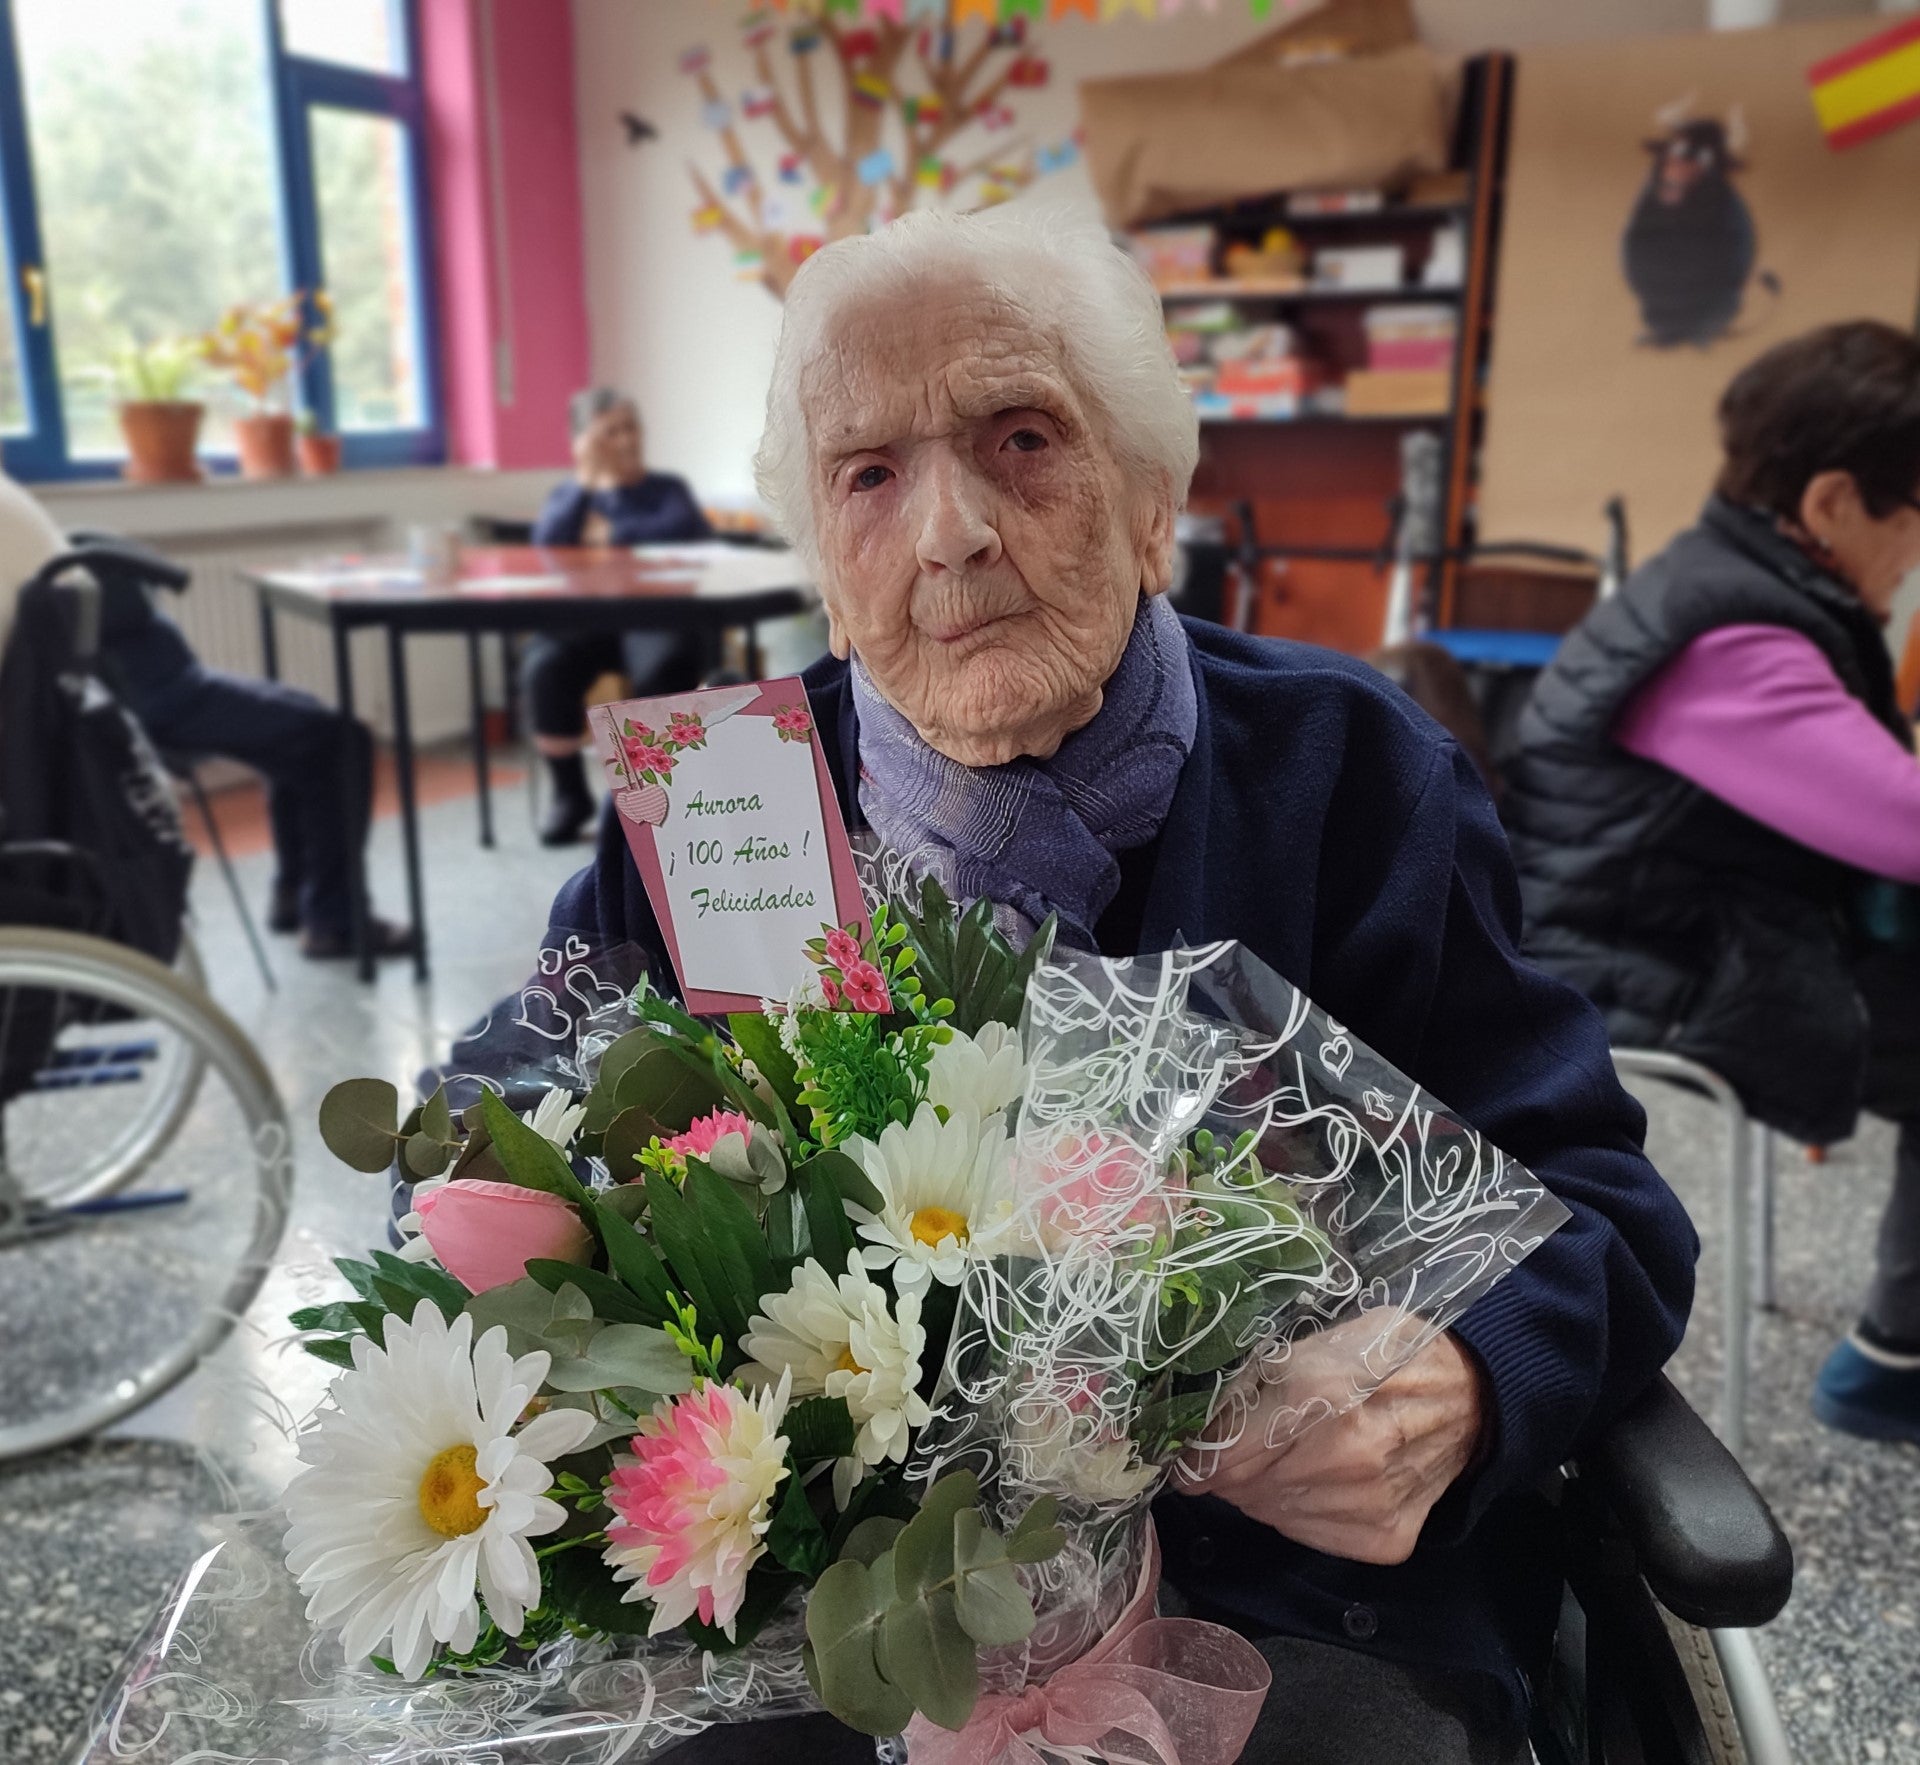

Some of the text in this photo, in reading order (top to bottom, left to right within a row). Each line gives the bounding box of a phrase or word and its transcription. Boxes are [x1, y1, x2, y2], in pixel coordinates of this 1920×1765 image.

[685, 789, 763, 820] Aurora
[733, 835, 791, 866] Años
[690, 884, 817, 919] Felicidades
